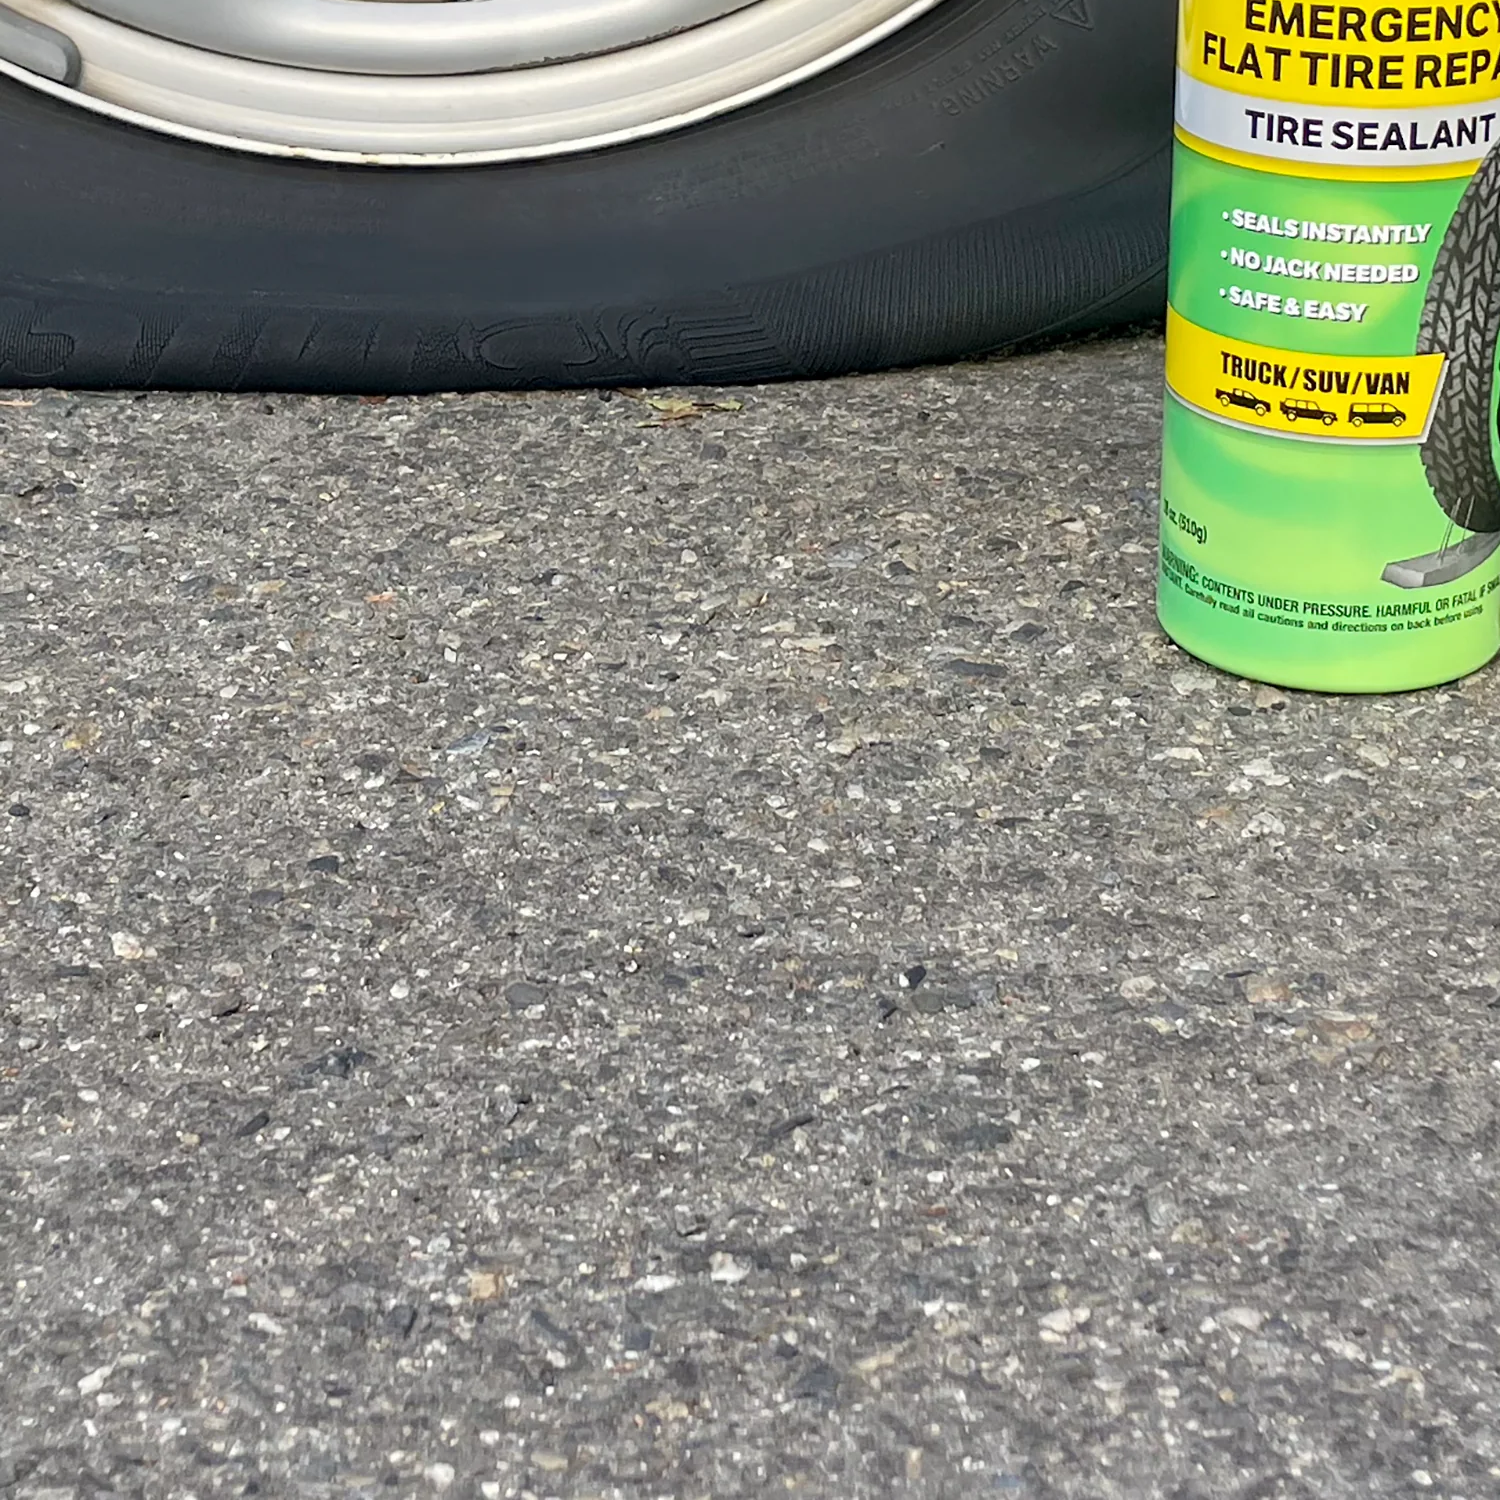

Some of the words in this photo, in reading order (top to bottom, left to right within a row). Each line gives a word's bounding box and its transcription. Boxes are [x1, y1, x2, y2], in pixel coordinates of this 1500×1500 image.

[1202, 30, 1291, 82] FLAT
[1300, 52, 1403, 90] TIRE
[1244, 109, 1323, 148] TIRE
[1330, 112, 1497, 151] SEALANT
[1232, 209, 1299, 239] SEALS
[1300, 220, 1432, 244] INSTANTLY
[1230, 248, 1260, 271] NO
[1263, 255, 1320, 280] JACK
[1324, 262, 1420, 283] NEEDED
[1228, 287, 1281, 315] SAFE
[1283, 298, 1301, 317] &
[1304, 300, 1368, 323] EASY
[1178, 512, 1208, 545] (510g)
[1202, 575, 1255, 605] CONTENTS
[1257, 594, 1299, 613] UNDER
[1302, 601, 1372, 618] PRESSURE.
[1376, 601, 1432, 618] HARMFUL
[1435, 597, 1450, 611] OR
[1452, 590, 1477, 609] FATAL
[1219, 600, 1240, 615] read
[1257, 612, 1304, 628] cautions
[1307, 620, 1328, 630] and
[1332, 621, 1387, 632] directions
[1391, 622, 1403, 631] on
[1407, 617, 1431, 630] back
[1434, 611, 1462, 627] before
